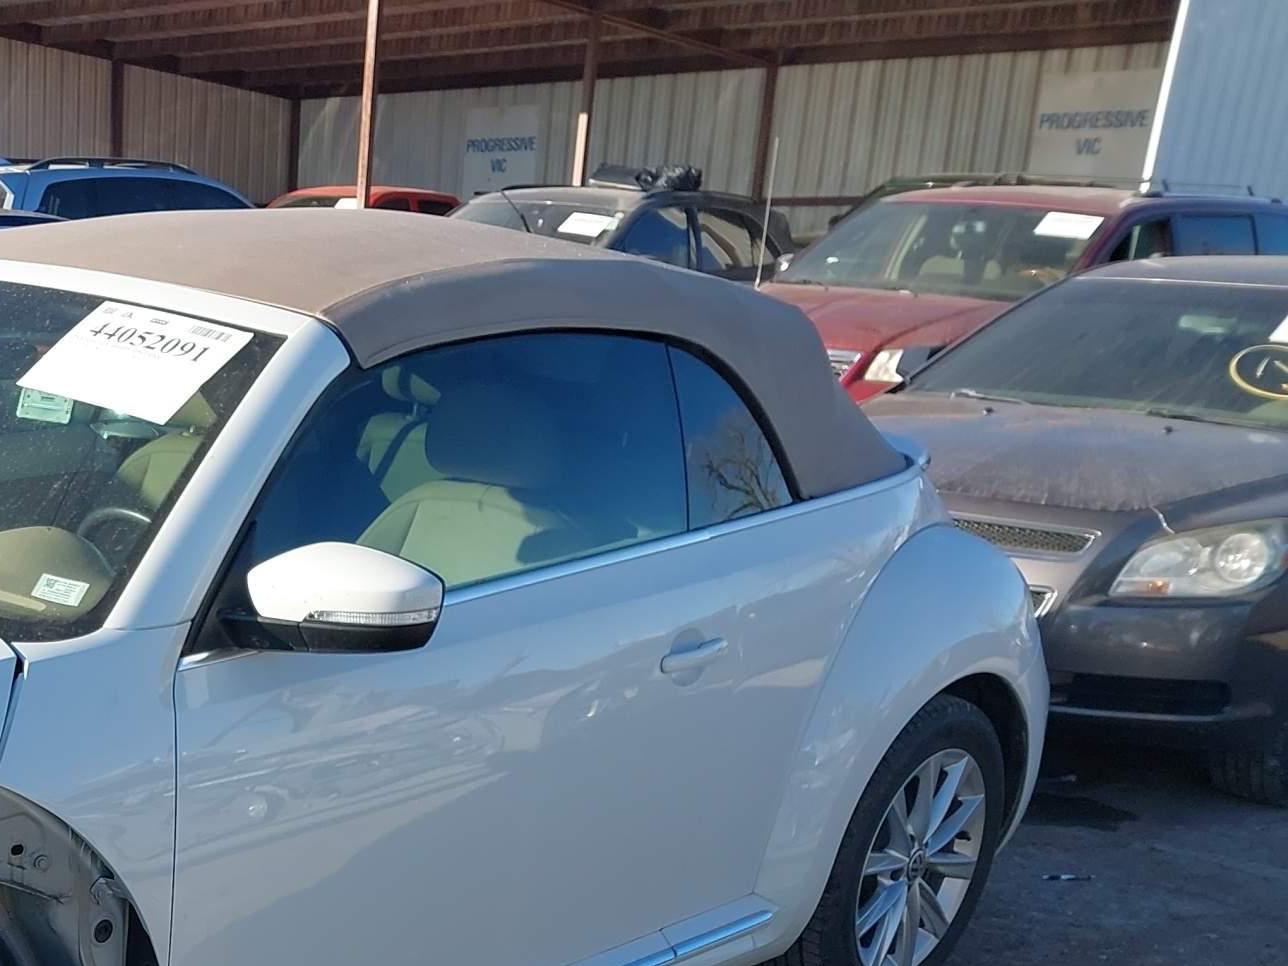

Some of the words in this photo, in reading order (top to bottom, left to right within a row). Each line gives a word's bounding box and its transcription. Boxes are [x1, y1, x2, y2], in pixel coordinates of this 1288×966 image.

[1039, 109, 1150, 129] PROGRESSIVE
[466, 136, 537, 152] PROGRESSIVE
[1076, 136, 1103, 155] VIC
[491, 158, 507, 173] VIC
[89, 322, 210, 362] 44052091
